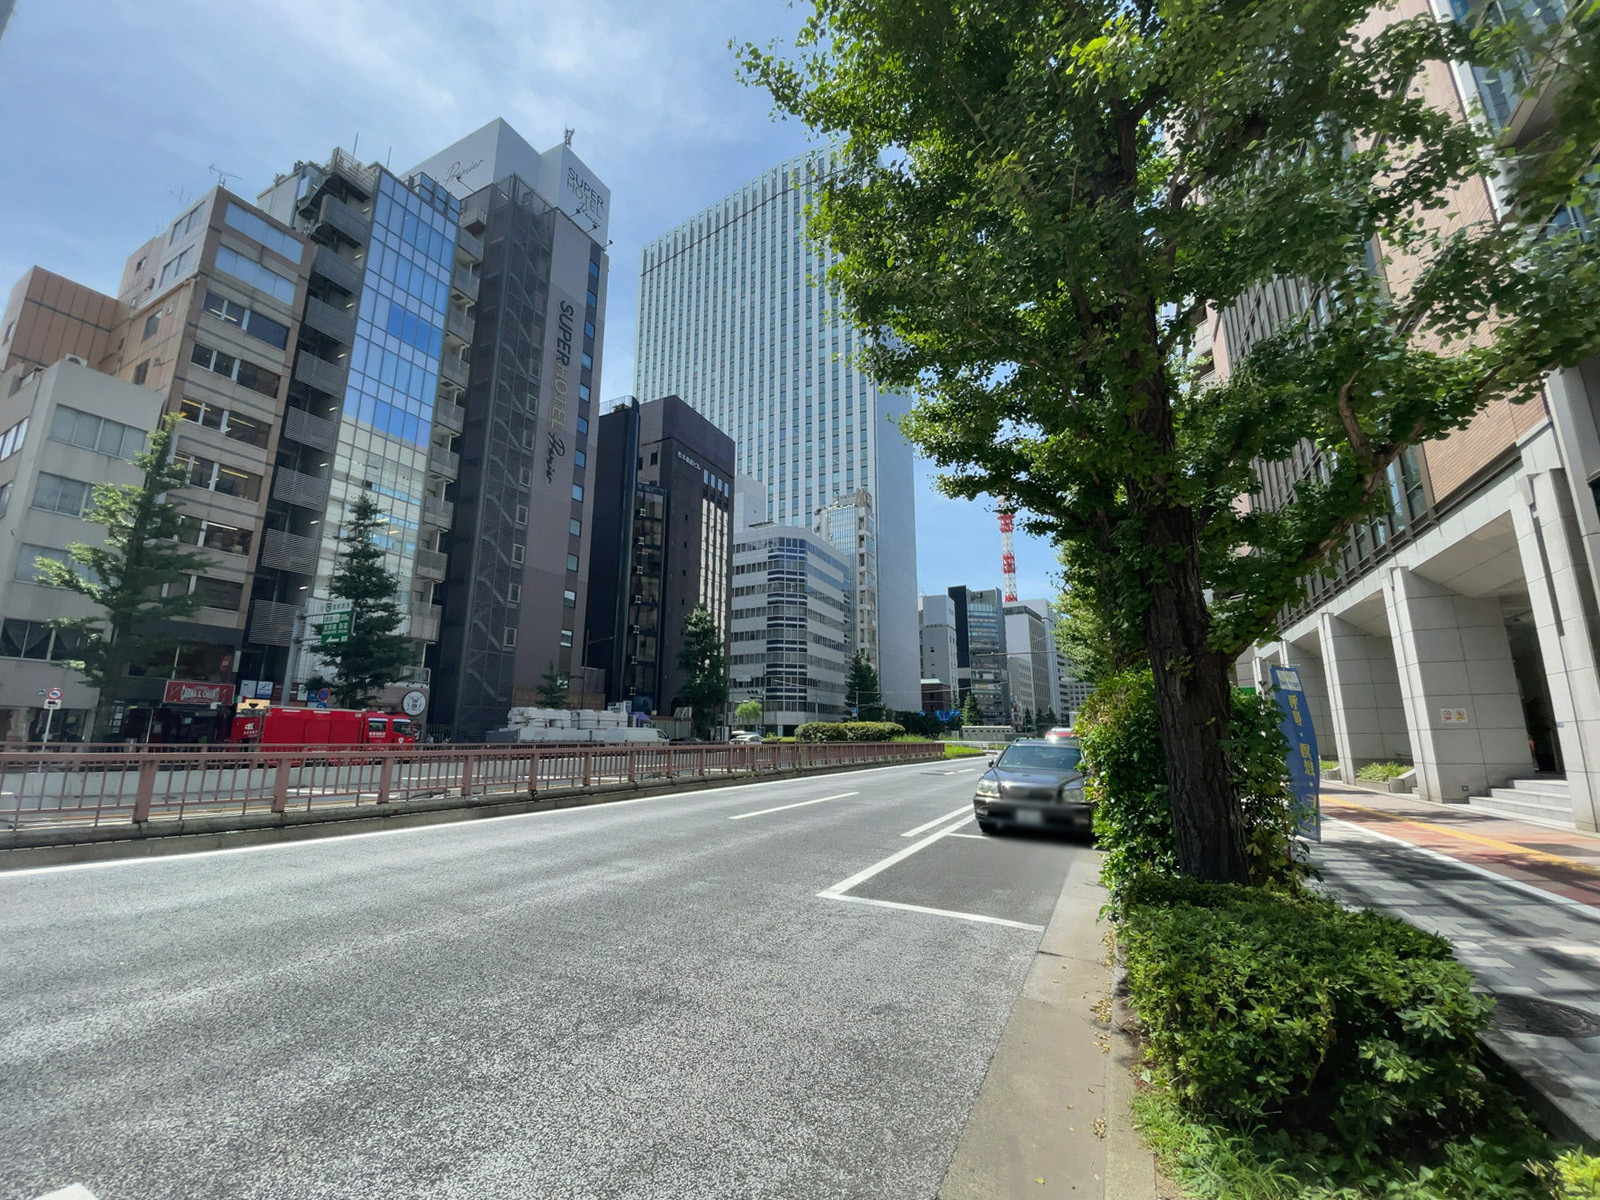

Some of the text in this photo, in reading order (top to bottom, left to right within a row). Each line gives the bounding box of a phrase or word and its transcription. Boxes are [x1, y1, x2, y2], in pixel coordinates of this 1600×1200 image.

[566, 177, 603, 220] HOTEL
[567, 167, 604, 210] SUPER
[556, 300, 575, 367] SUPER
[551, 362, 569, 432] HOTEL
